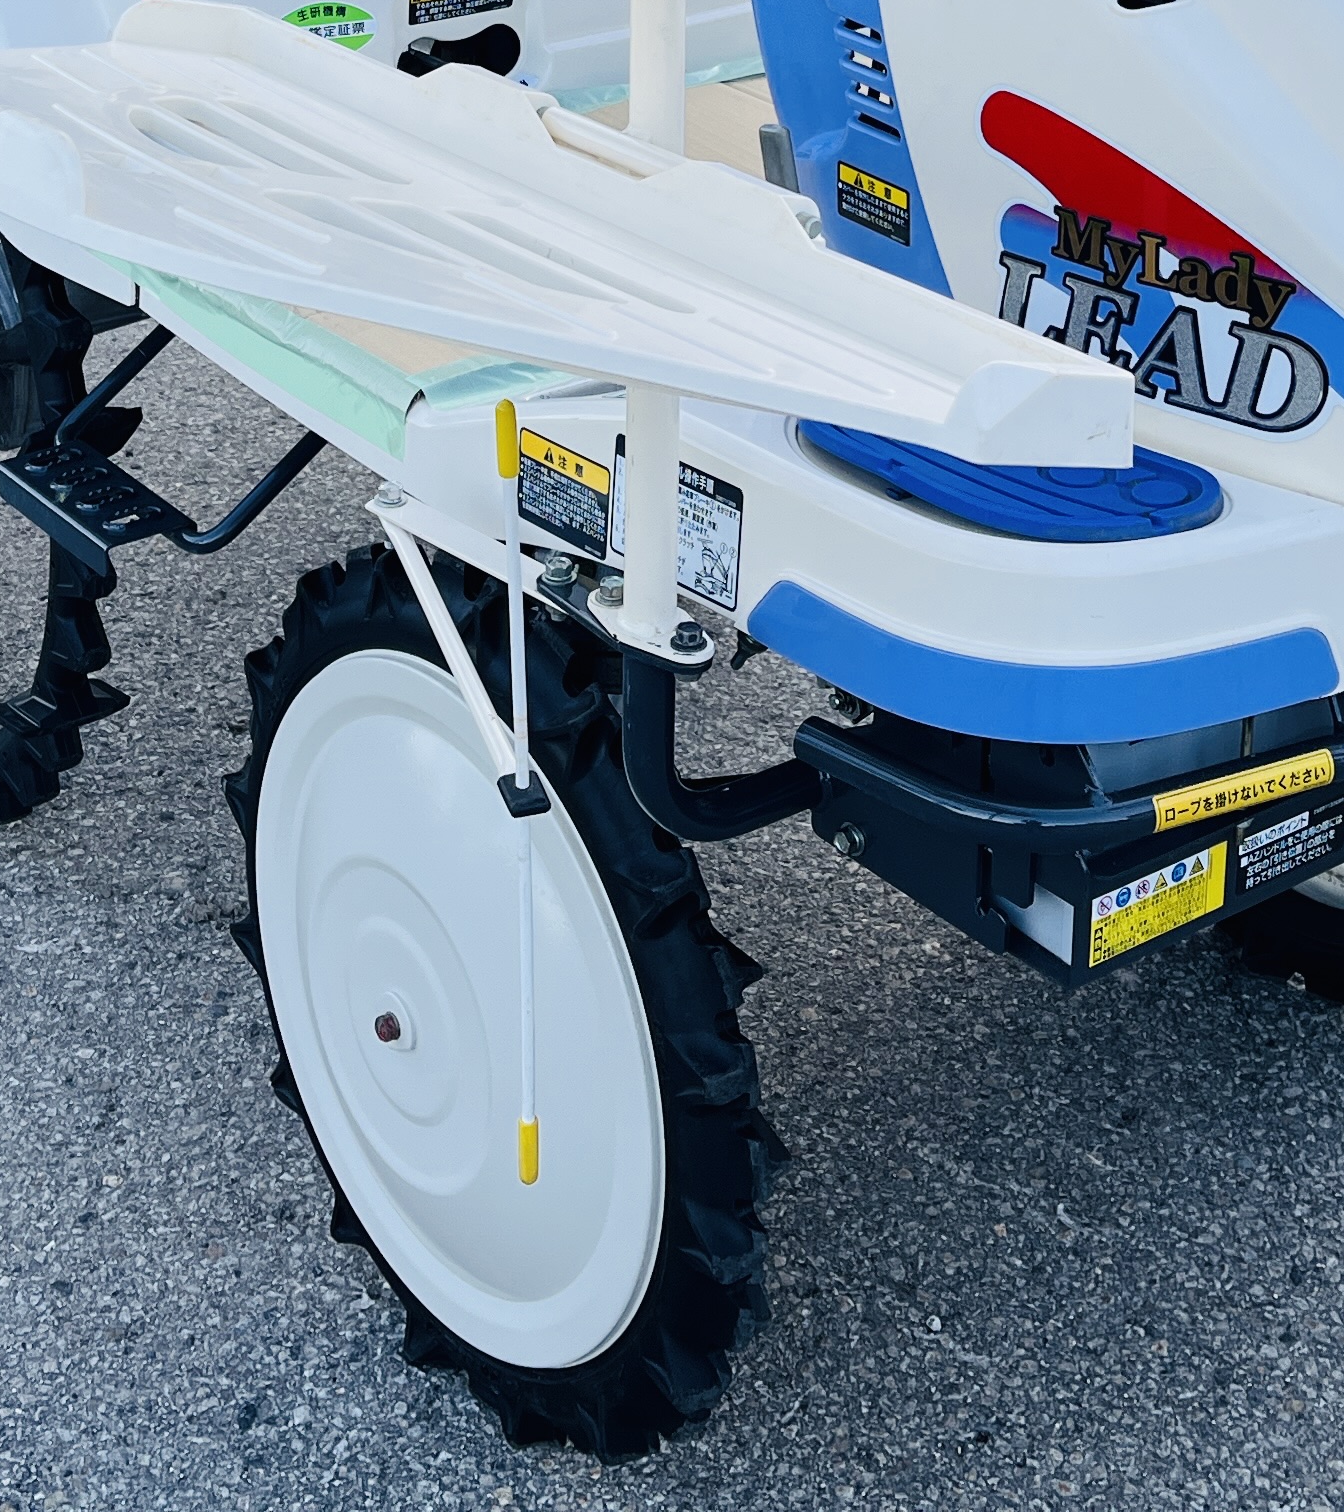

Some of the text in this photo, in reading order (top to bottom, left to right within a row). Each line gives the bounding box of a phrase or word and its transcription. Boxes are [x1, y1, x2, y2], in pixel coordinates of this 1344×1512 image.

[867, 178, 892, 200] 注意
[1051, 205, 1296, 328] MyLady
[999, 251, 1330, 433] LEAD
[557, 453, 584, 478] 注意
[1165, 766, 1326, 823] ロープを掛けないでください
